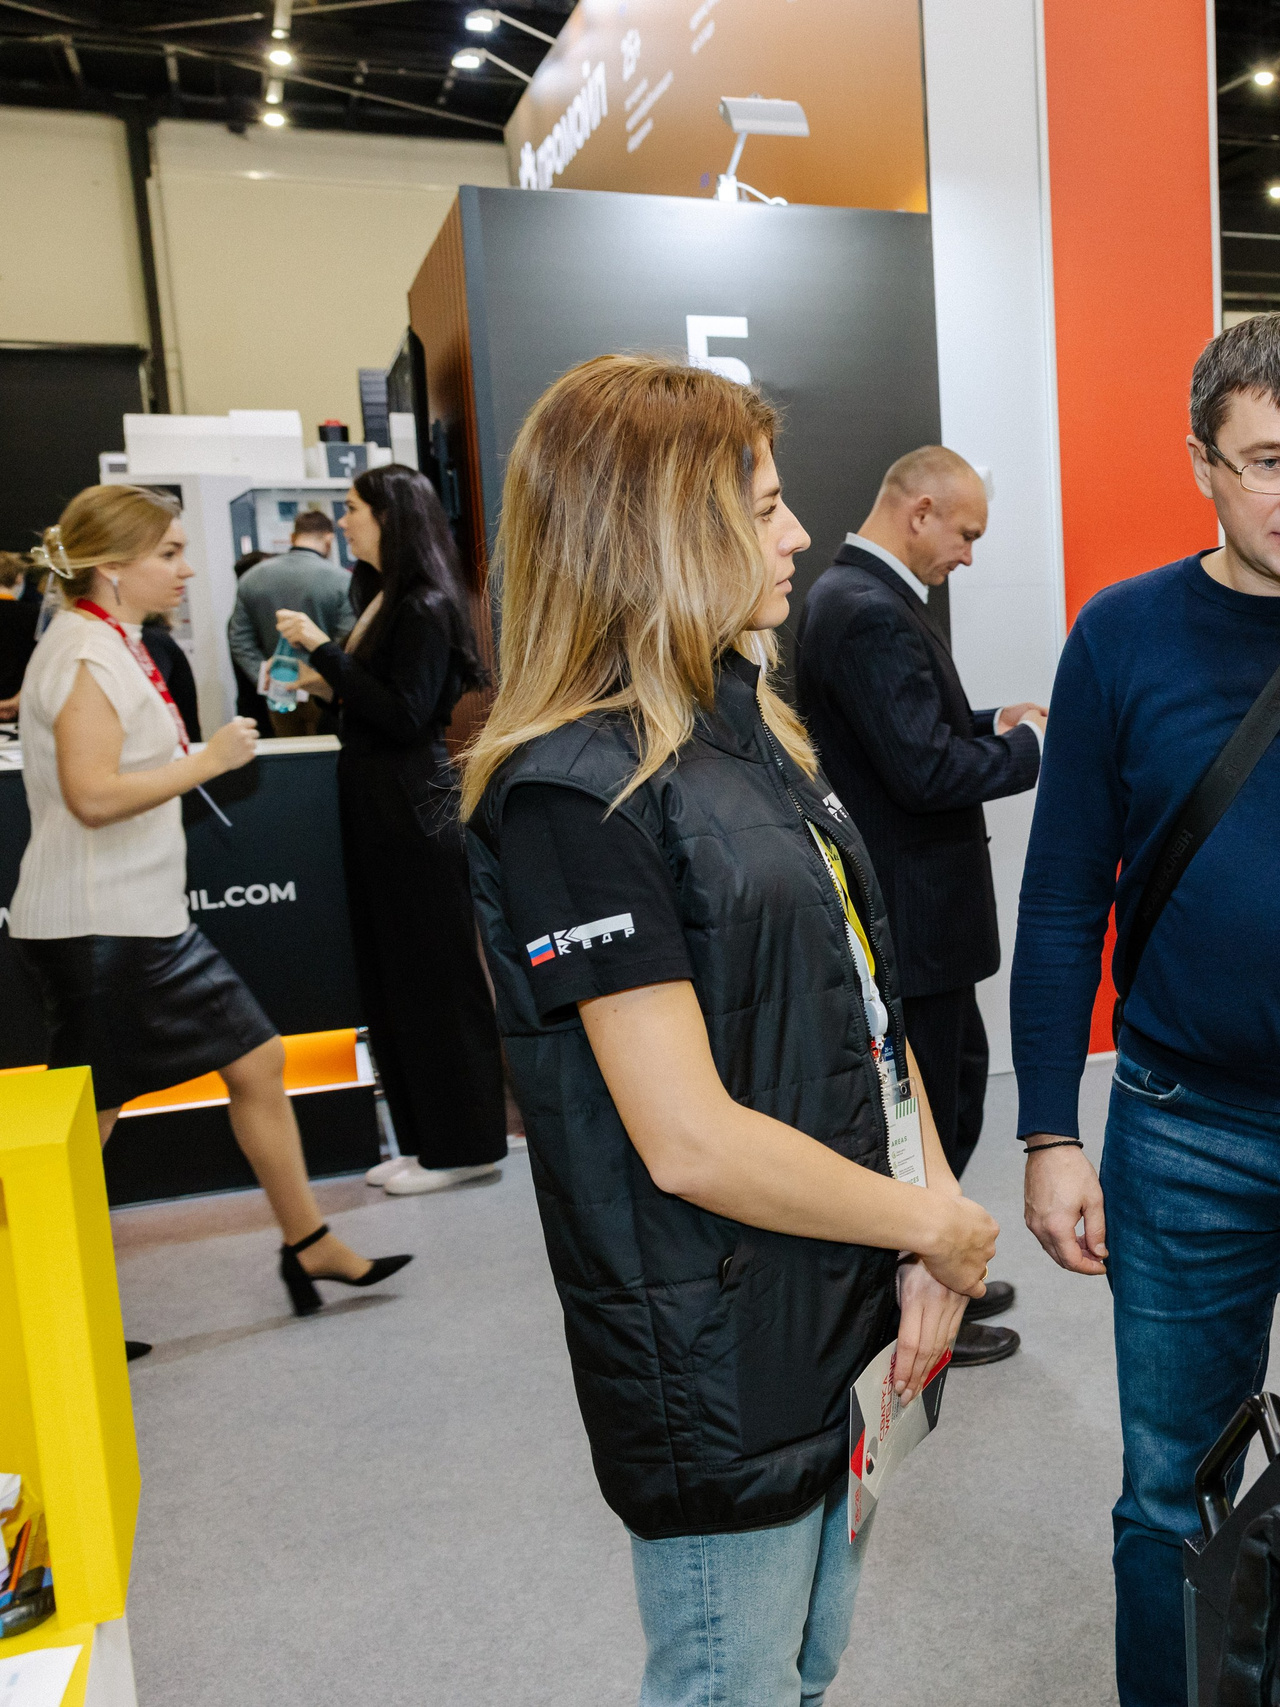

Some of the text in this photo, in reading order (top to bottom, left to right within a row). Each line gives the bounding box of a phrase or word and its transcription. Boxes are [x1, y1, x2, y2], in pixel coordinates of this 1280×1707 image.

[185, 880, 297, 912] IL.COM
[556, 926, 636, 956] КЕДР
[890, 1135, 908, 1148] AREAS
